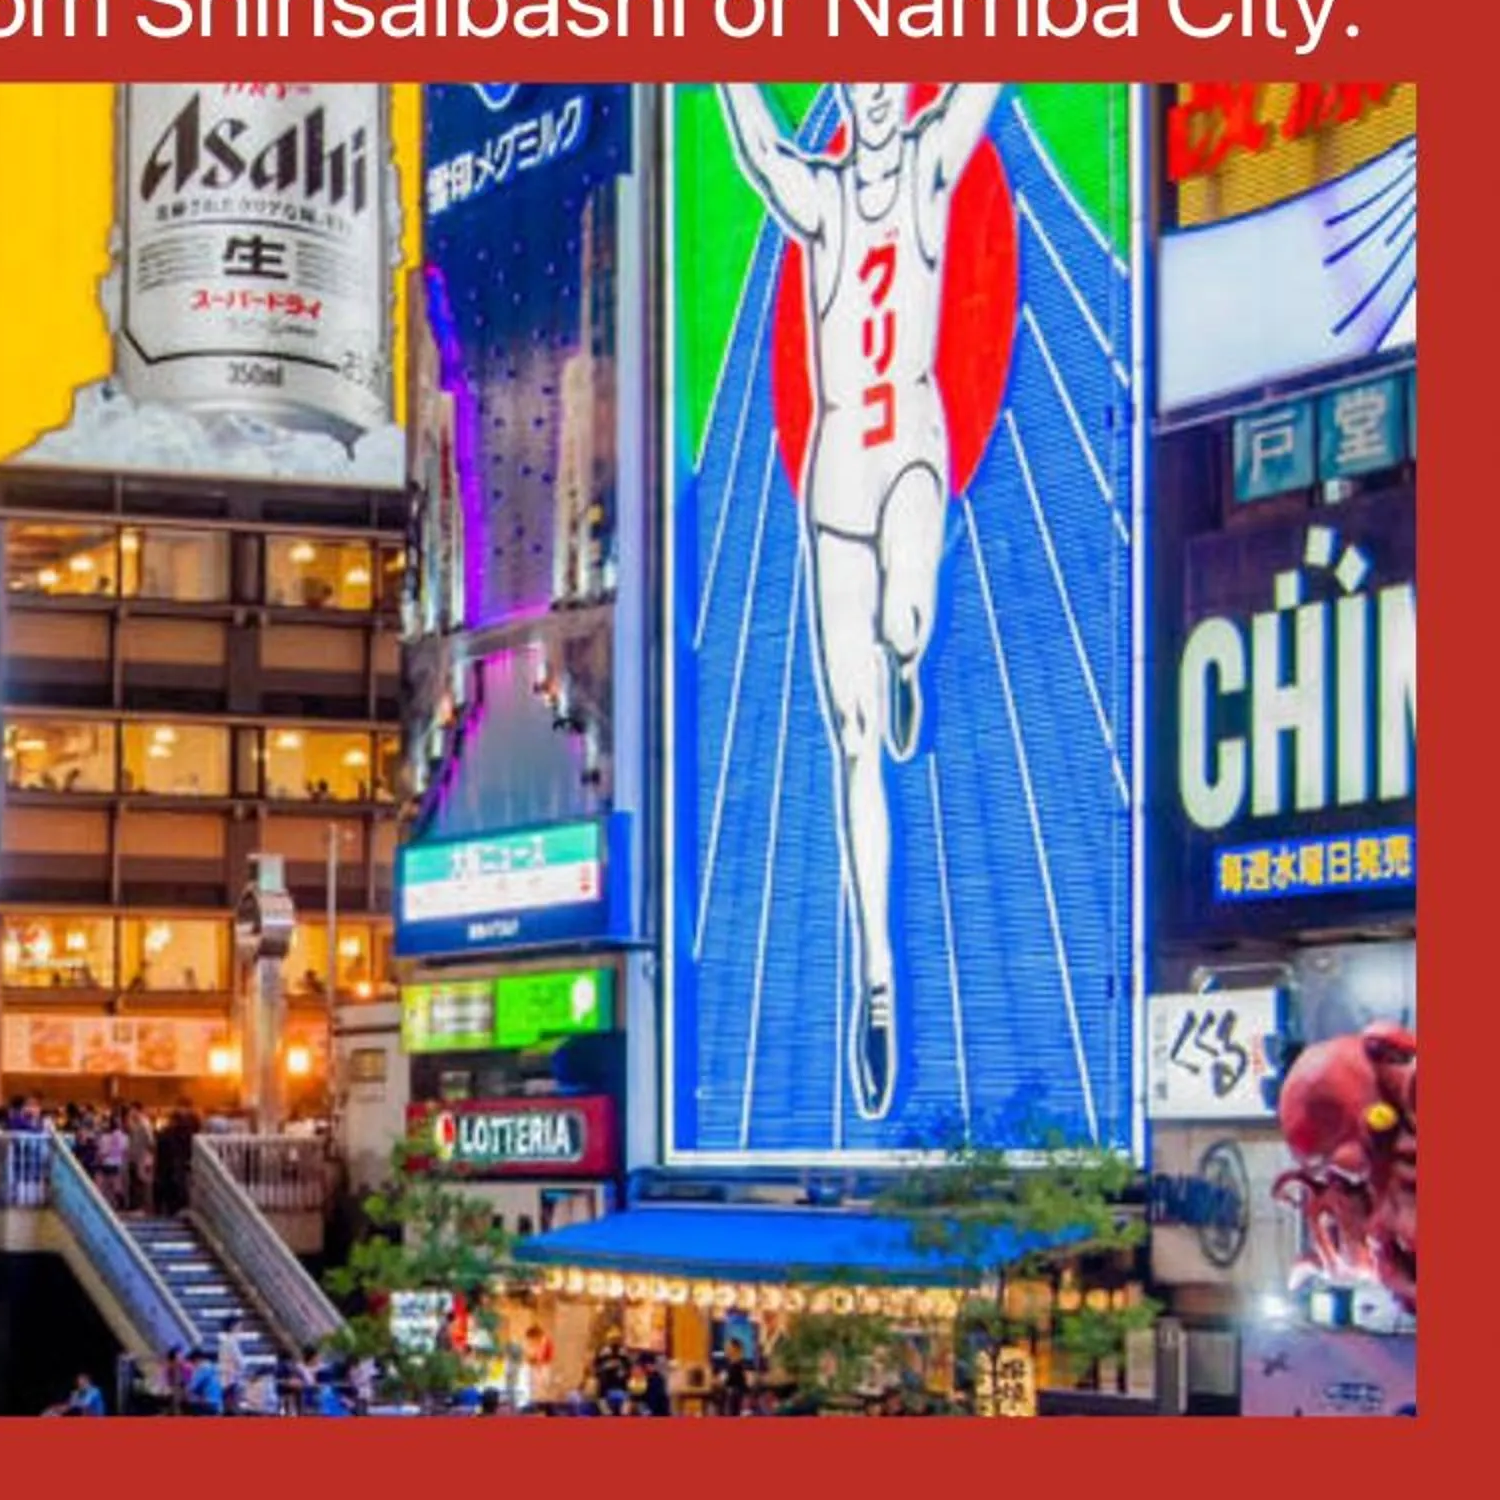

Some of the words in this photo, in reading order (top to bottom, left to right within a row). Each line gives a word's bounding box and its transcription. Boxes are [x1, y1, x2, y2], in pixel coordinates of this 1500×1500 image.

[141, 91, 367, 216] Asahi
[223, 235, 289, 282] 生
[190, 288, 323, 320] スーパードライ
[858, 243, 896, 449] グリコ
[1170, 1009, 1247, 1098] くくる
[459, 1113, 572, 1155] LOTTERIA
